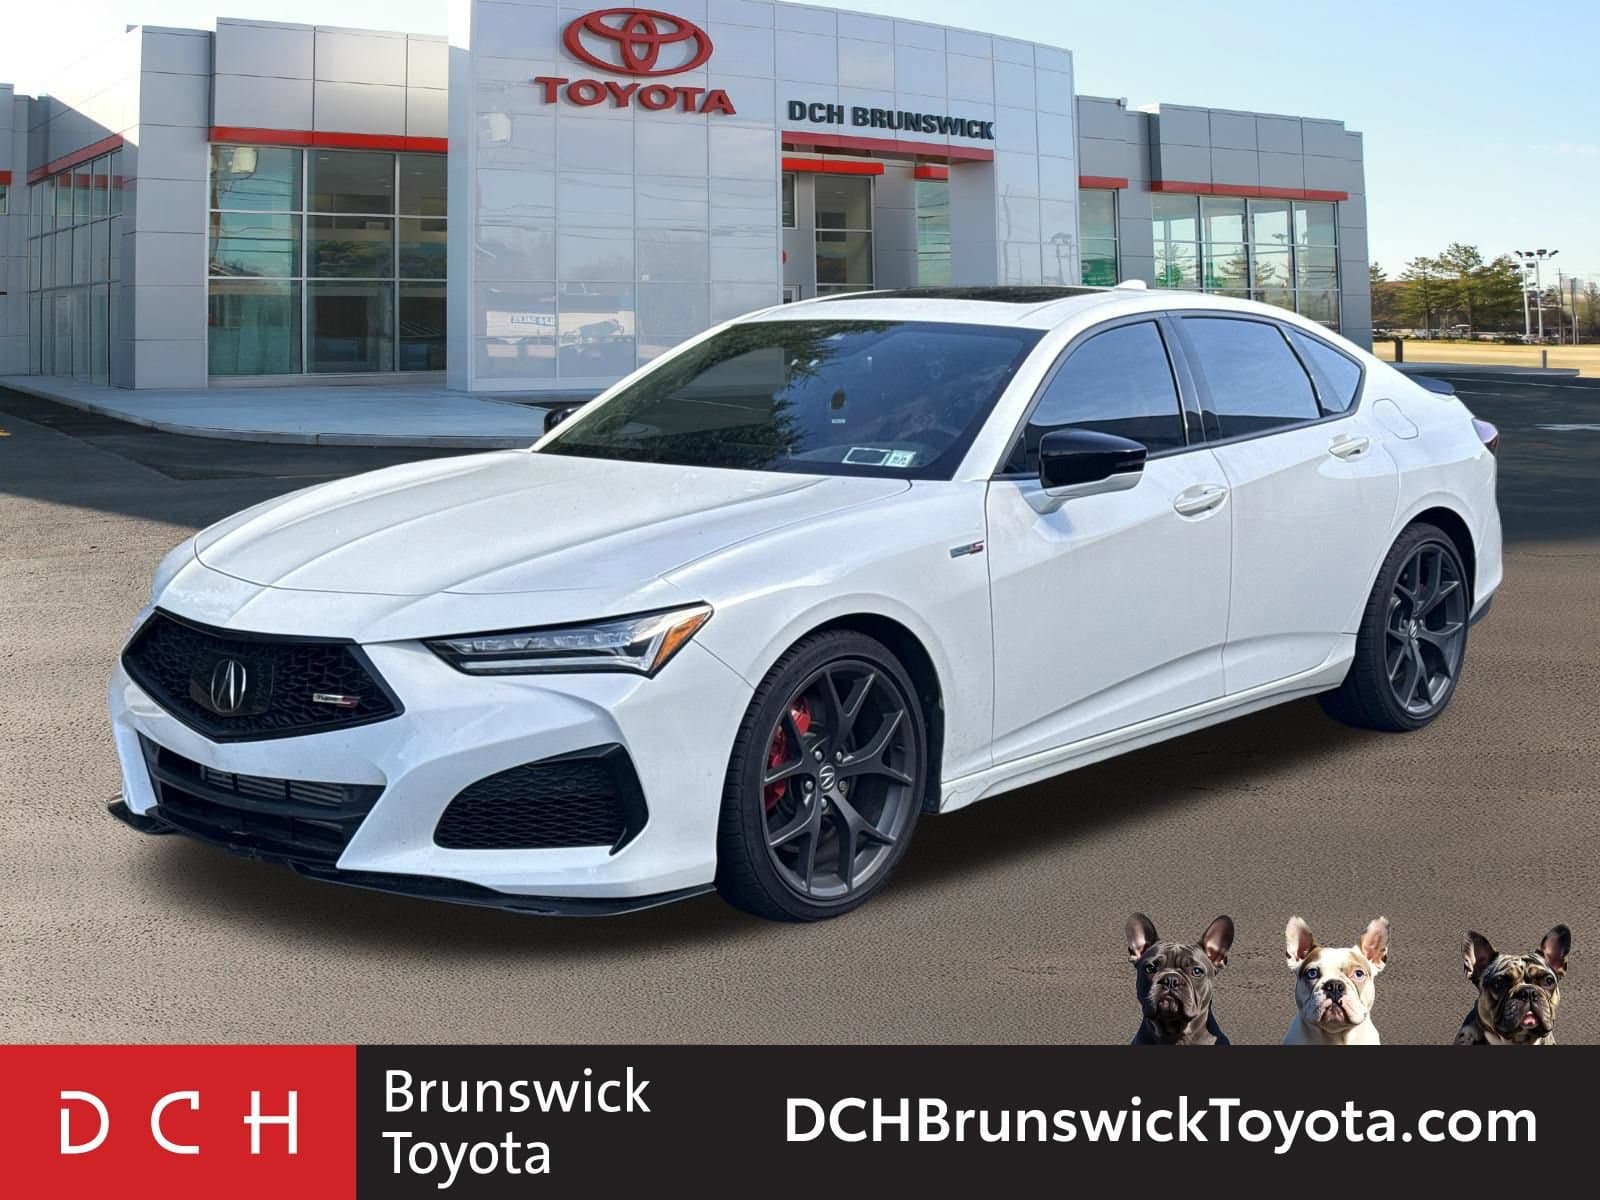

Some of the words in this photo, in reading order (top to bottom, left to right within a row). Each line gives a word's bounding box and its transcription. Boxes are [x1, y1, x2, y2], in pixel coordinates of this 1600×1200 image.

[534, 76, 736, 115] TOYOTA
[788, 100, 845, 125] DCH
[852, 107, 995, 141] BRUNSWICK
